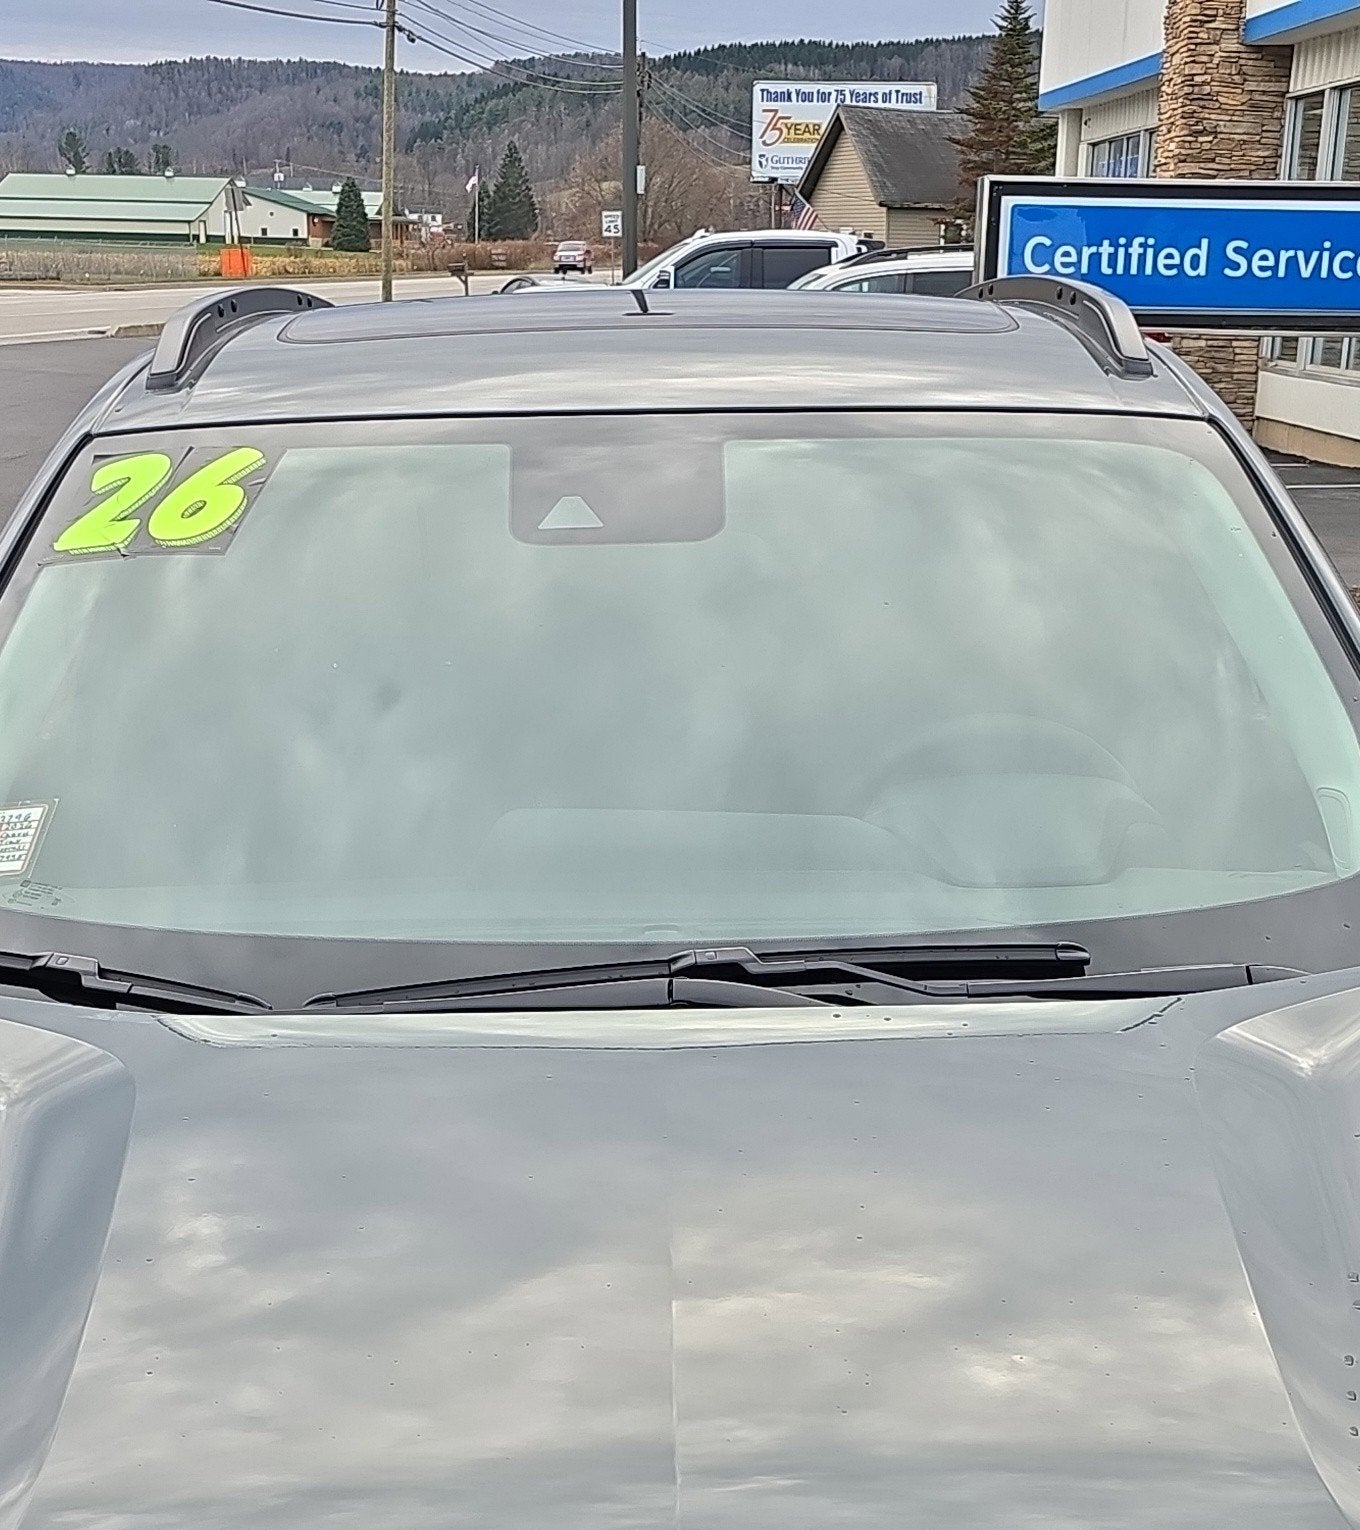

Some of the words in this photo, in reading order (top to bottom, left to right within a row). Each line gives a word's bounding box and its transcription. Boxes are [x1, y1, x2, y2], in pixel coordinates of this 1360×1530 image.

[760, 88, 793, 103] Thank
[795, 88, 814, 103] You
[816, 88, 832, 103] for
[834, 89, 846, 104] 75
[849, 89, 879, 104] Years
[882, 90, 892, 104] of
[894, 90, 923, 104] Trust
[758, 108, 792, 147] 75
[784, 123, 821, 136] YEAR
[604, 224, 620, 234] 45
[1022, 235, 1209, 277] Certified
[53, 446, 266, 554] 26
